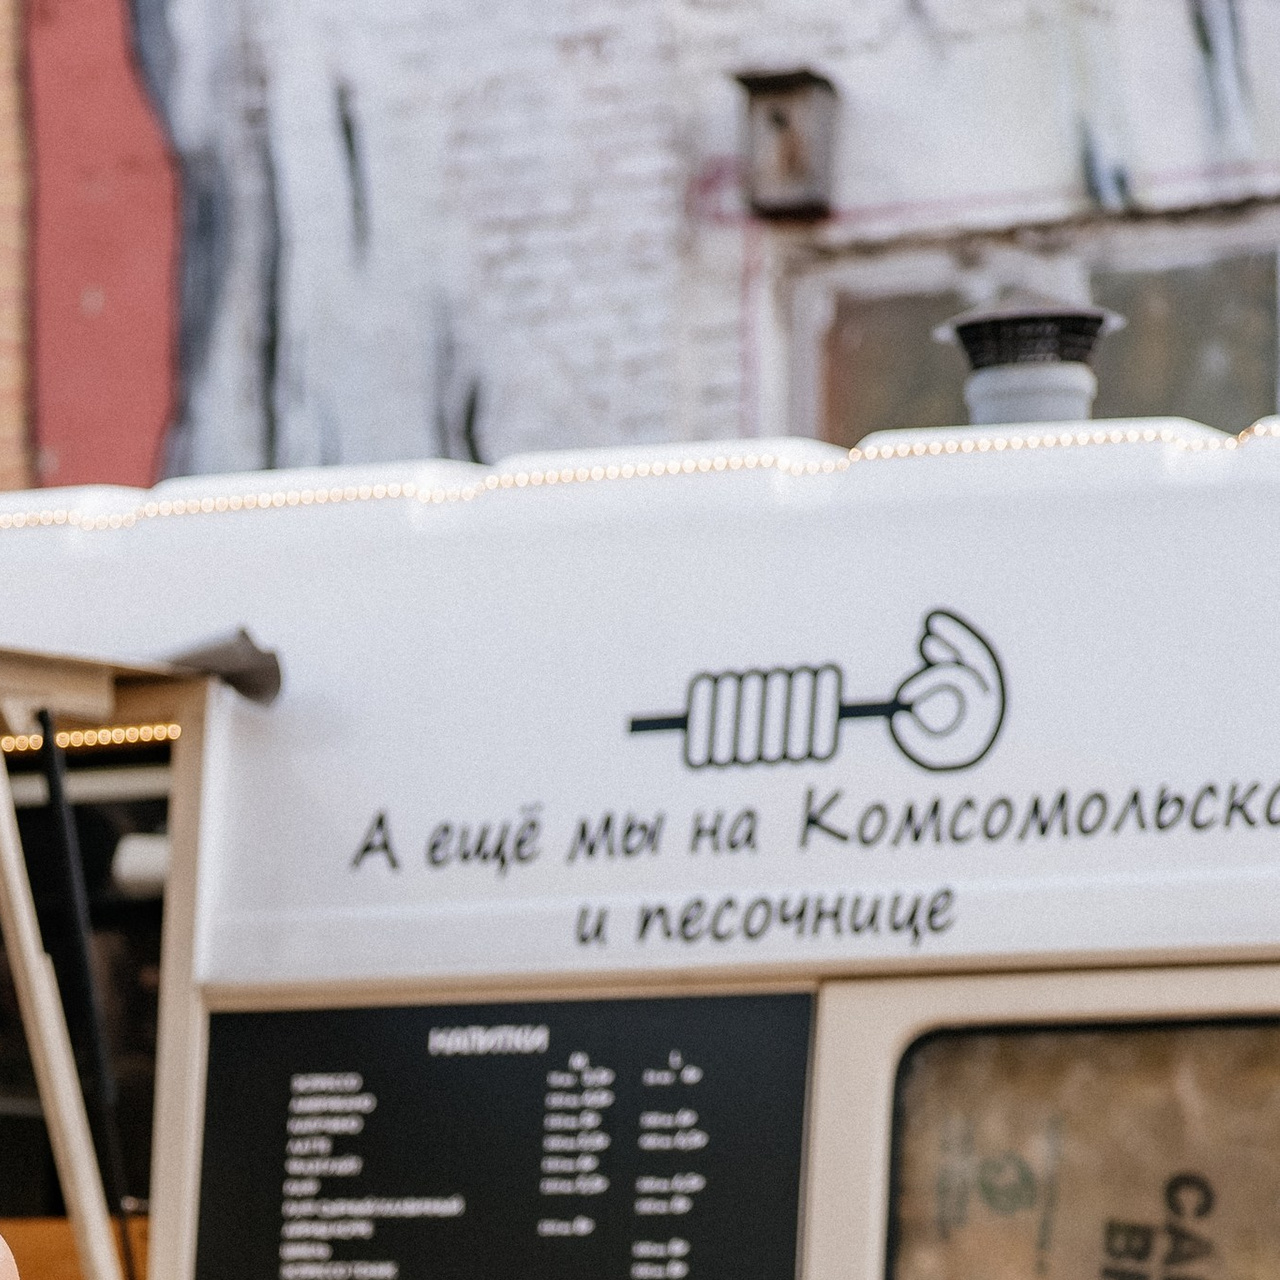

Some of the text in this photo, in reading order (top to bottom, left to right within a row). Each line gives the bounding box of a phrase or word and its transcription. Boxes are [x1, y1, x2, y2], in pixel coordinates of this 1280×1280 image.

[350, 808, 401, 871] А
[424, 801, 545, 880] ещё
[567, 809, 666, 866] мы
[690, 808, 760, 853] на
[576, 886, 956, 946] и песочнице
